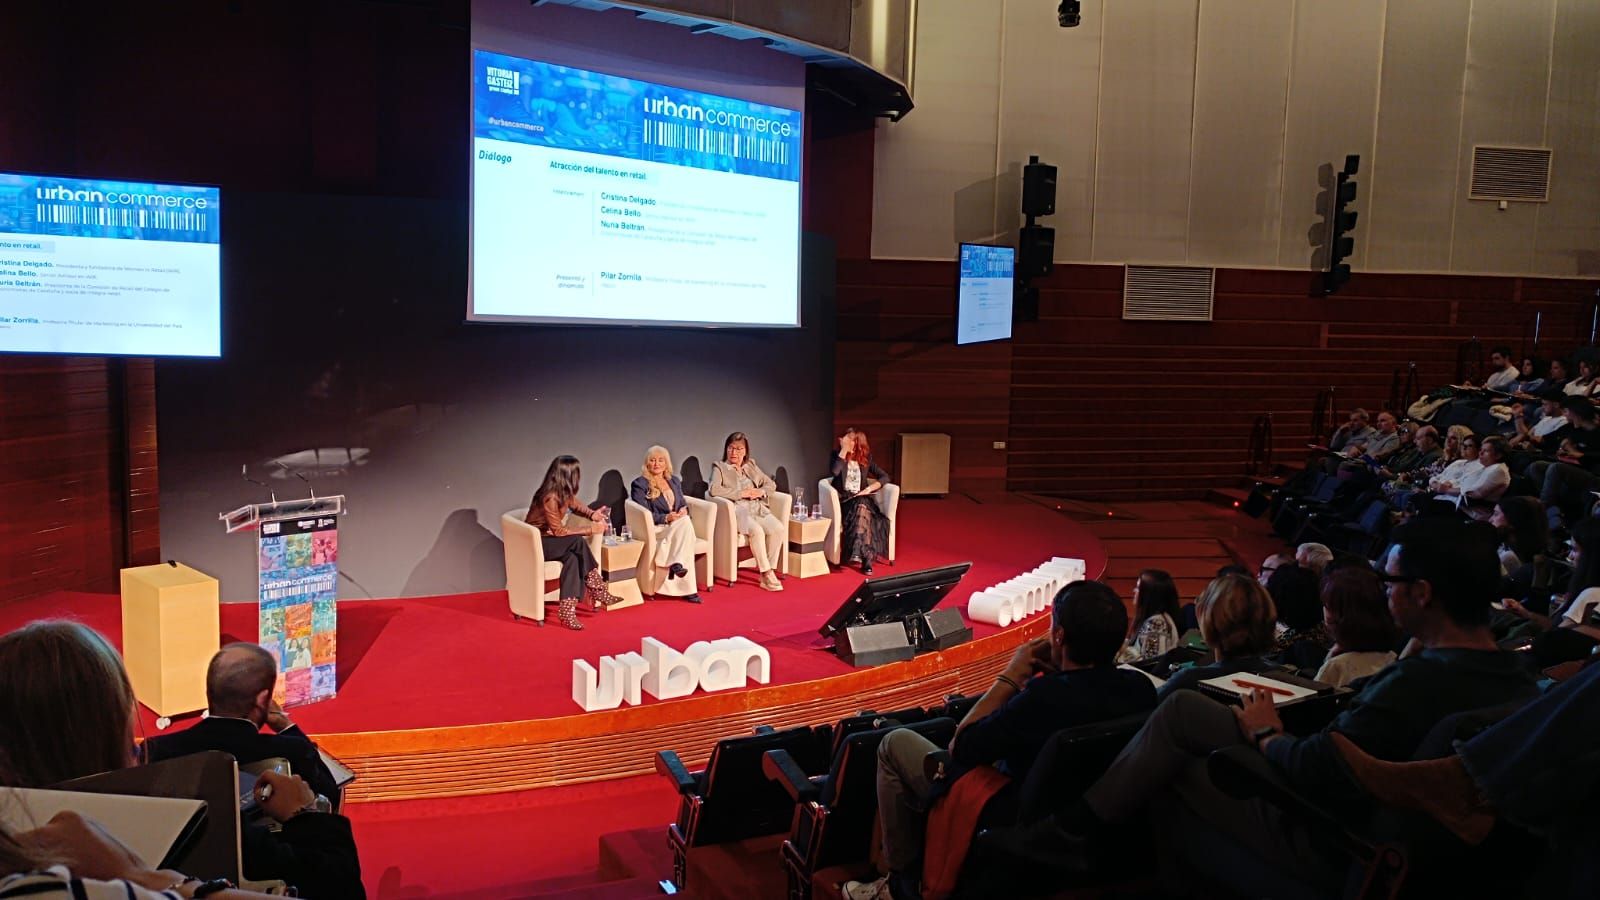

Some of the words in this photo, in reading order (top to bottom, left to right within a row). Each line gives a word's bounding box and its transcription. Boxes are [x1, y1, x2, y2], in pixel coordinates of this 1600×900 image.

[644, 96, 704, 121] urban
[705, 109, 791, 137] commerce
[478, 150, 512, 165] Diálogo
[550, 161, 582, 172] Atracción
[595, 167, 619, 177] talento
[36, 185, 103, 203] urban
[106, 192, 208, 209] commerce
[601, 192, 627, 203] Cristina
[601, 206, 622, 215] Celina
[23, 260, 54, 268] Delgado.
[601, 271, 616, 280] Pilar
[264, 580, 292, 590] urban
[571, 636, 770, 712] urban
